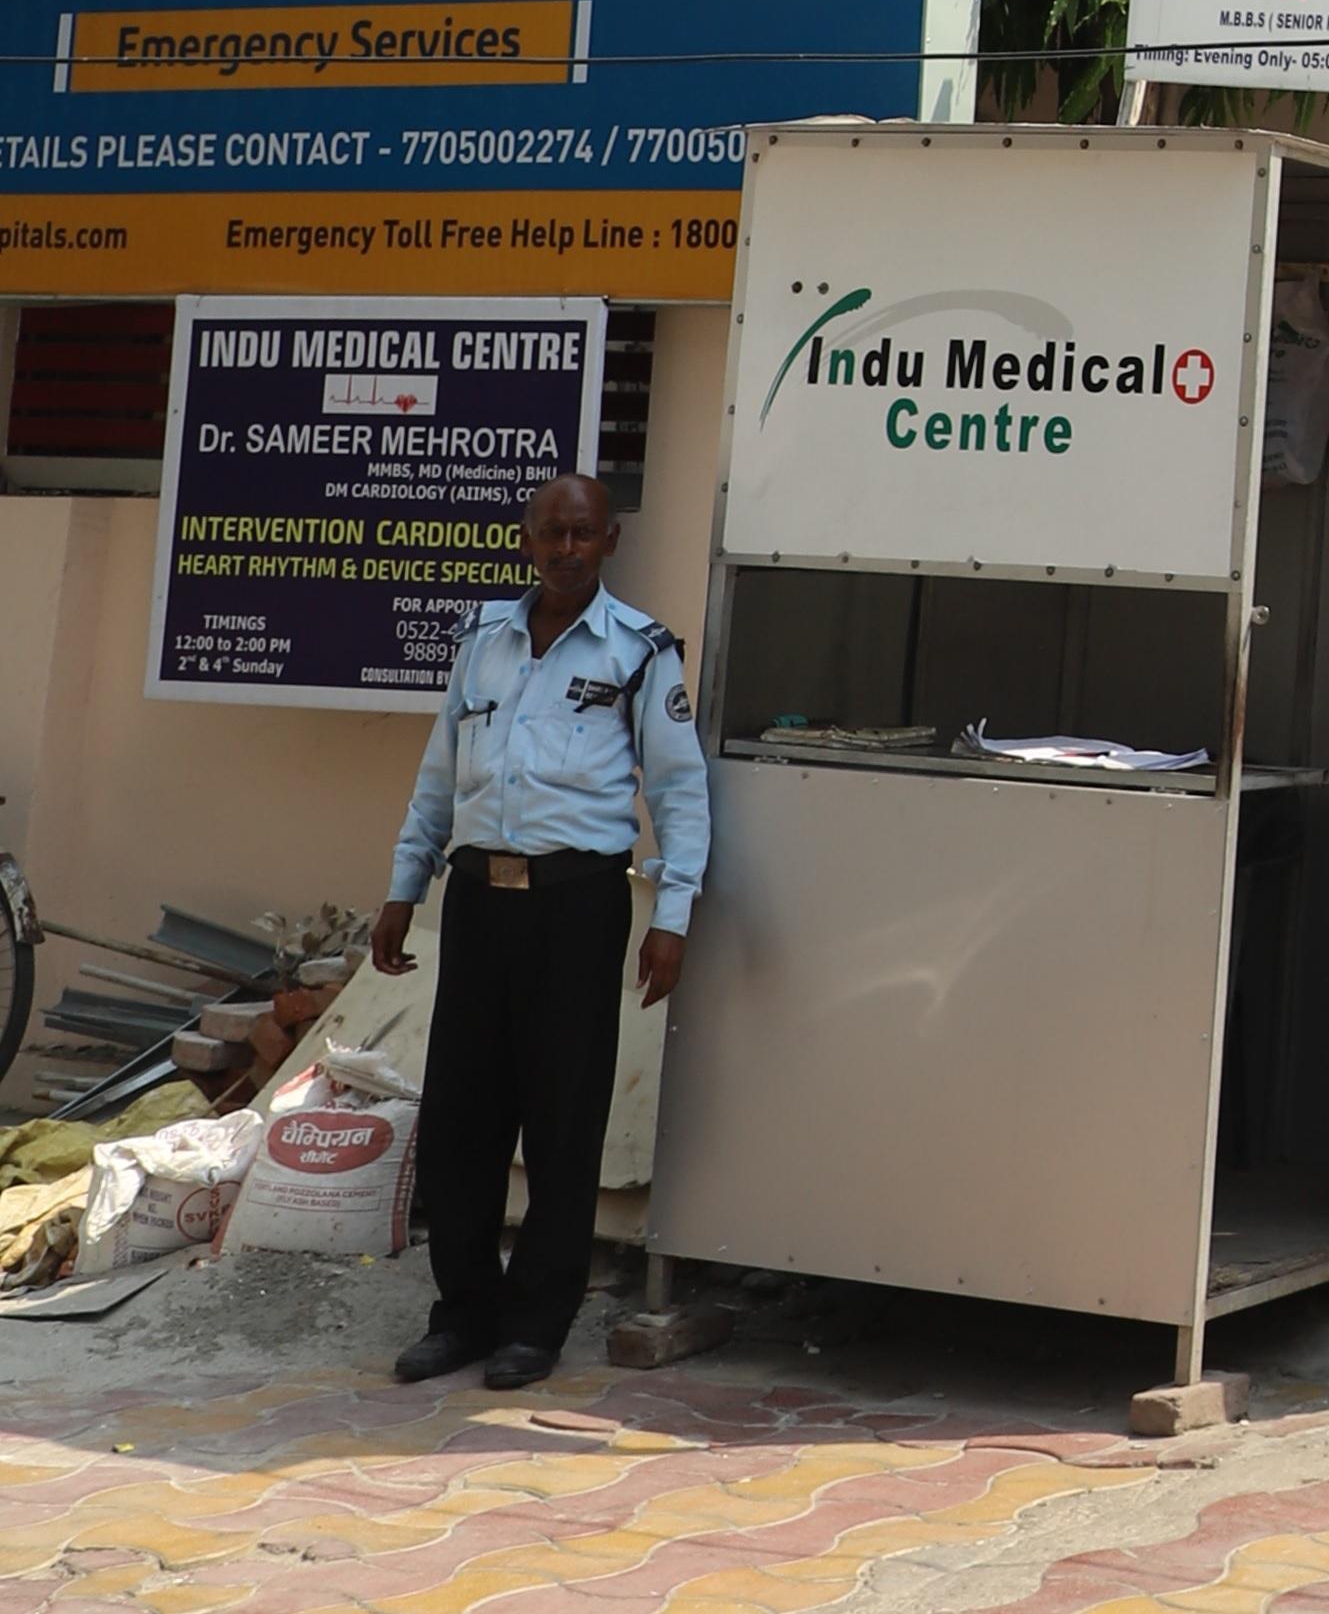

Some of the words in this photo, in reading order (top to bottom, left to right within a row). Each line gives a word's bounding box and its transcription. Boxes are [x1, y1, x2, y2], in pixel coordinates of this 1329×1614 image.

[1220, 10, 1265, 28] M.B.B.S
[1277, 13, 1323, 31] SENIOR
[117, 26, 338, 75] Emergency
[351, 17, 521, 61] Services
[1193, 46, 1252, 70] Evening
[0, 135, 88, 169] TAILS
[98, 133, 217, 167] PLEASE
[225, 131, 370, 166] CONTACT
[402, 129, 593, 165] 7705002274
[601, 125, 620, 166] /
[226, 220, 376, 255] Emergency
[384, 219, 432, 249] Toll
[441, 219, 501, 248] Free
[511, 219, 574, 255] Help
[583, 219, 643, 248] Line
[671, 219, 737, 248] 1800
[199, 330, 281, 368] INDU
[291, 330, 440, 369] MEDICAL
[452, 331, 580, 370] CENTRE
[807, 336, 924, 388] Indu
[946, 339, 1165, 395] Medical
[886, 398, 1072, 454] Centre
[198, 424, 236, 453] Dr.
[245, 424, 372, 455] SAMEER
[380, 425, 559, 458] MEHROTRA
[419, 464, 442, 478] MD
[446, 465, 521, 483] (Medicine)
[526, 466, 557, 480] BHU
[326, 483, 348, 497] DM
[352, 484, 446, 499] CARDIOLOGY
[182, 516, 364, 544] INTERVENTION
[178, 554, 245, 576] HEART
[248, 555, 336, 578] RHYTHM
[341, 558, 357, 580] &
[362, 559, 435, 583] DEVICE
[393, 597, 422, 612] FOR
[203, 615, 266, 631] TIMINGS
[175, 635, 214, 650] 12:00
[217, 637, 231, 651] to
[235, 637, 266, 652] 2:00
[269, 638, 291, 653] PM
[198, 657, 209, 671] &
[232, 658, 284, 677] Sunday
[361, 667, 434, 684] CONSULTATION
